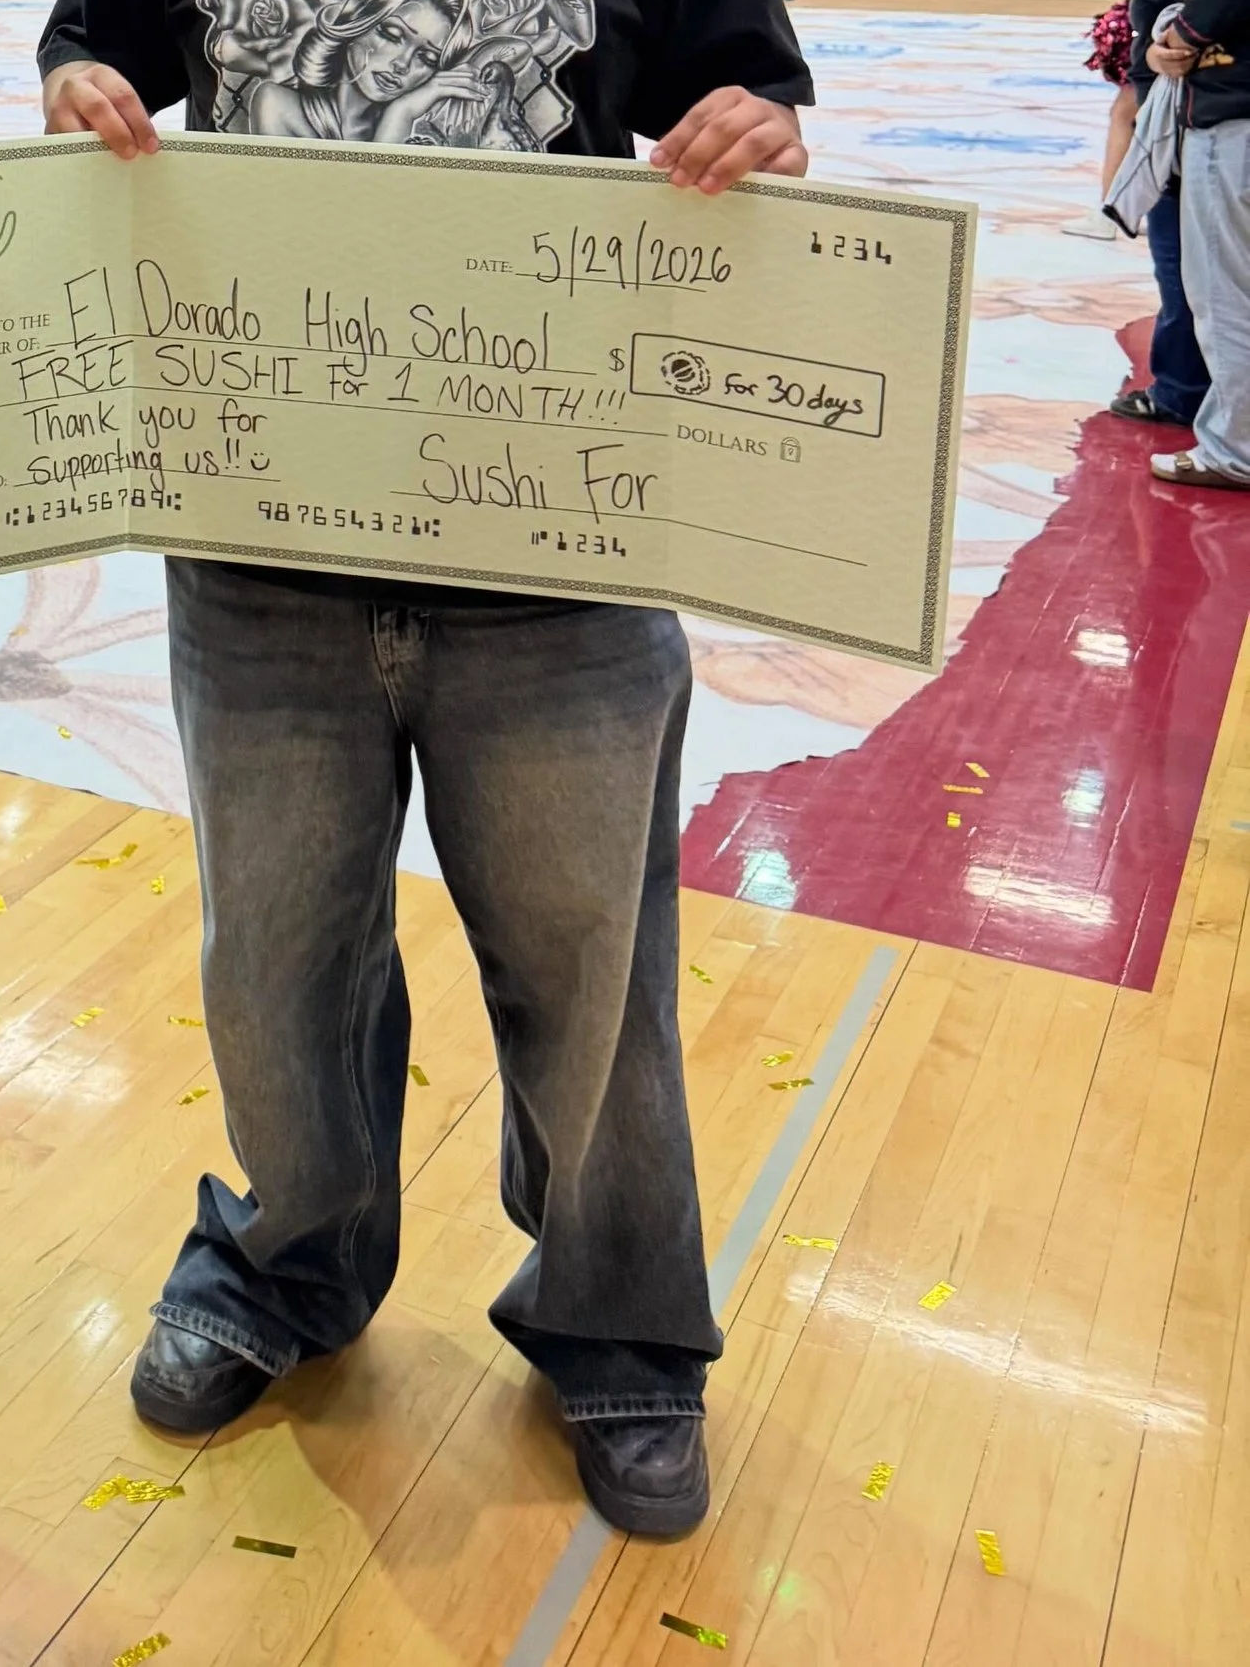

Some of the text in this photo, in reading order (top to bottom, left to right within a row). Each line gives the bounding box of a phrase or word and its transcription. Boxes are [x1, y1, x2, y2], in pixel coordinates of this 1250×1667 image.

[465, 257, 514, 274] DATE:
[534, 220, 731, 297] 5/29/2026
[810, 231, 892, 266] 1234
[19, 313, 51, 330] THE
[136, 259, 261, 341] Dorado
[306, 287, 388, 377] High
[410, 304, 548, 374] School
[16, 337, 41, 353] OF:
[608, 348, 626, 373] $
[11, 340, 135, 400] FREE
[155, 344, 303, 395] SUSHI
[387, 361, 420, 403] 1
[436, 373, 626, 426] MONTH!!!
[766, 374, 805, 408] 30
[806, 383, 864, 427] days
[23, 397, 268, 449] Thank you for
[676, 424, 769, 456] DOLLARS
[185, 437, 241, 476] us!!
[419, 433, 659, 524] Sushi For
